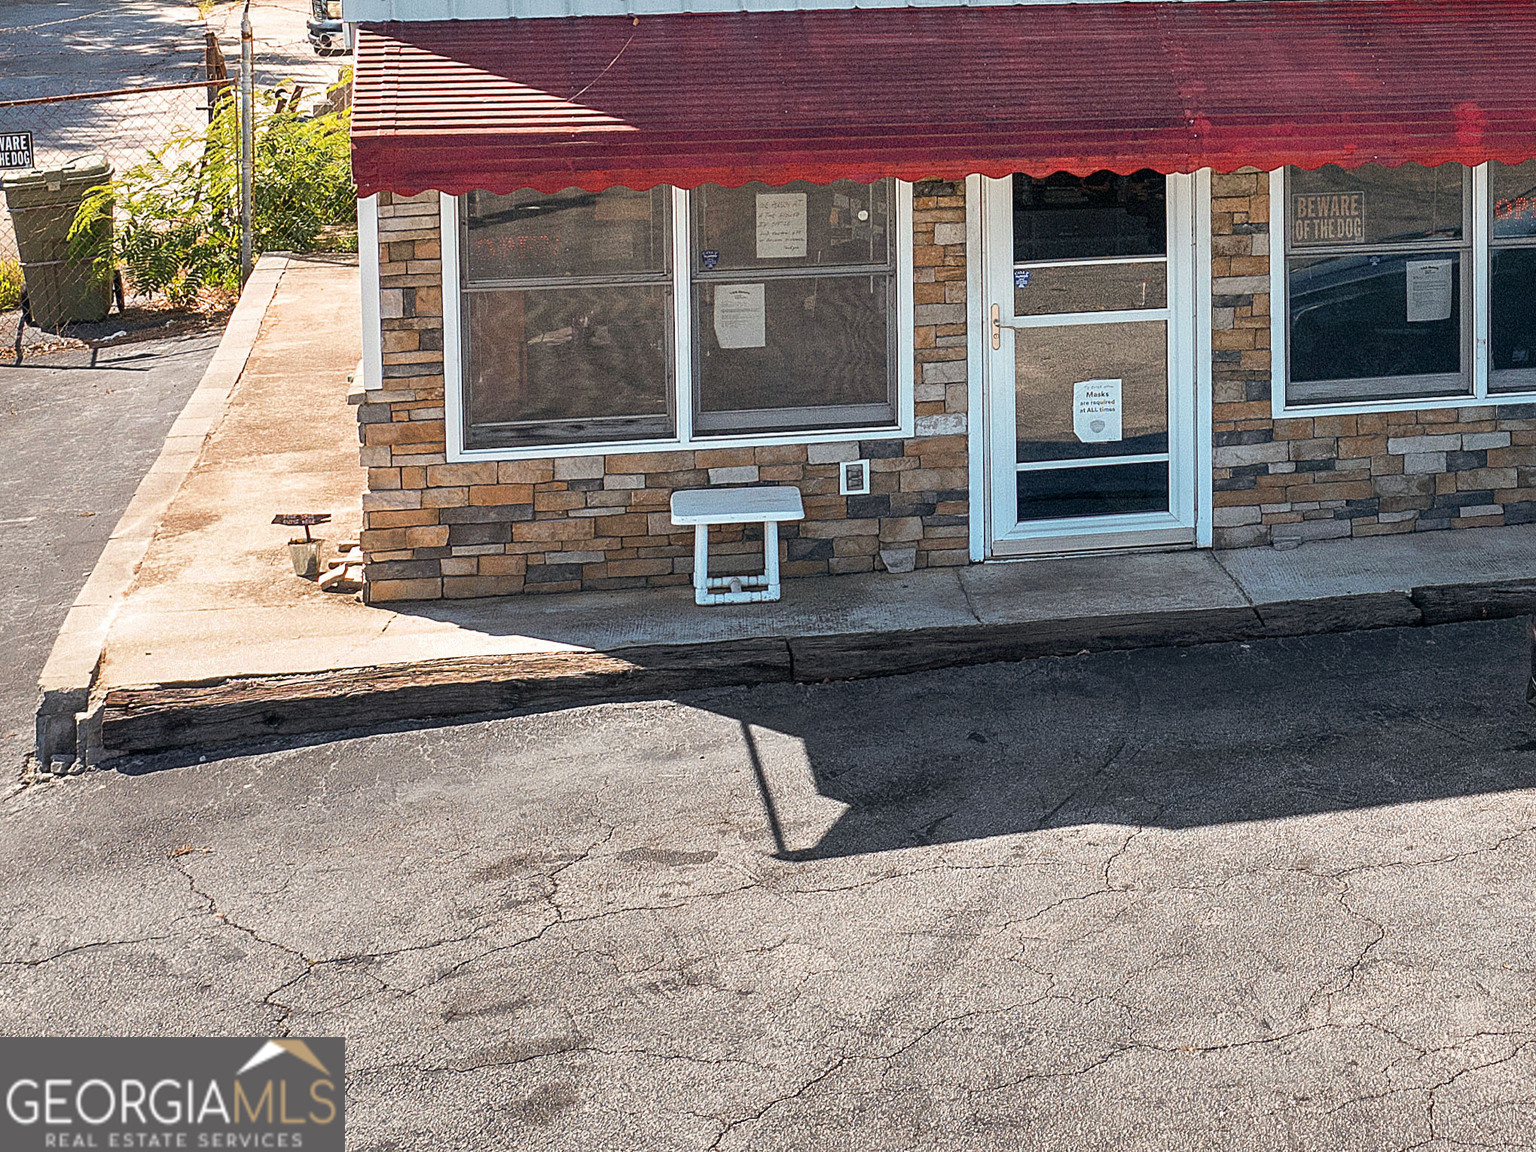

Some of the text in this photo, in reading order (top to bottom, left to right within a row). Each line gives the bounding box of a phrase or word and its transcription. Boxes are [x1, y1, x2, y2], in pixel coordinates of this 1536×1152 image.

[11, 150, 30, 166] DOG
[1297, 194, 1360, 218] BEWARE
[1295, 217, 1362, 240] OF THE DOG
